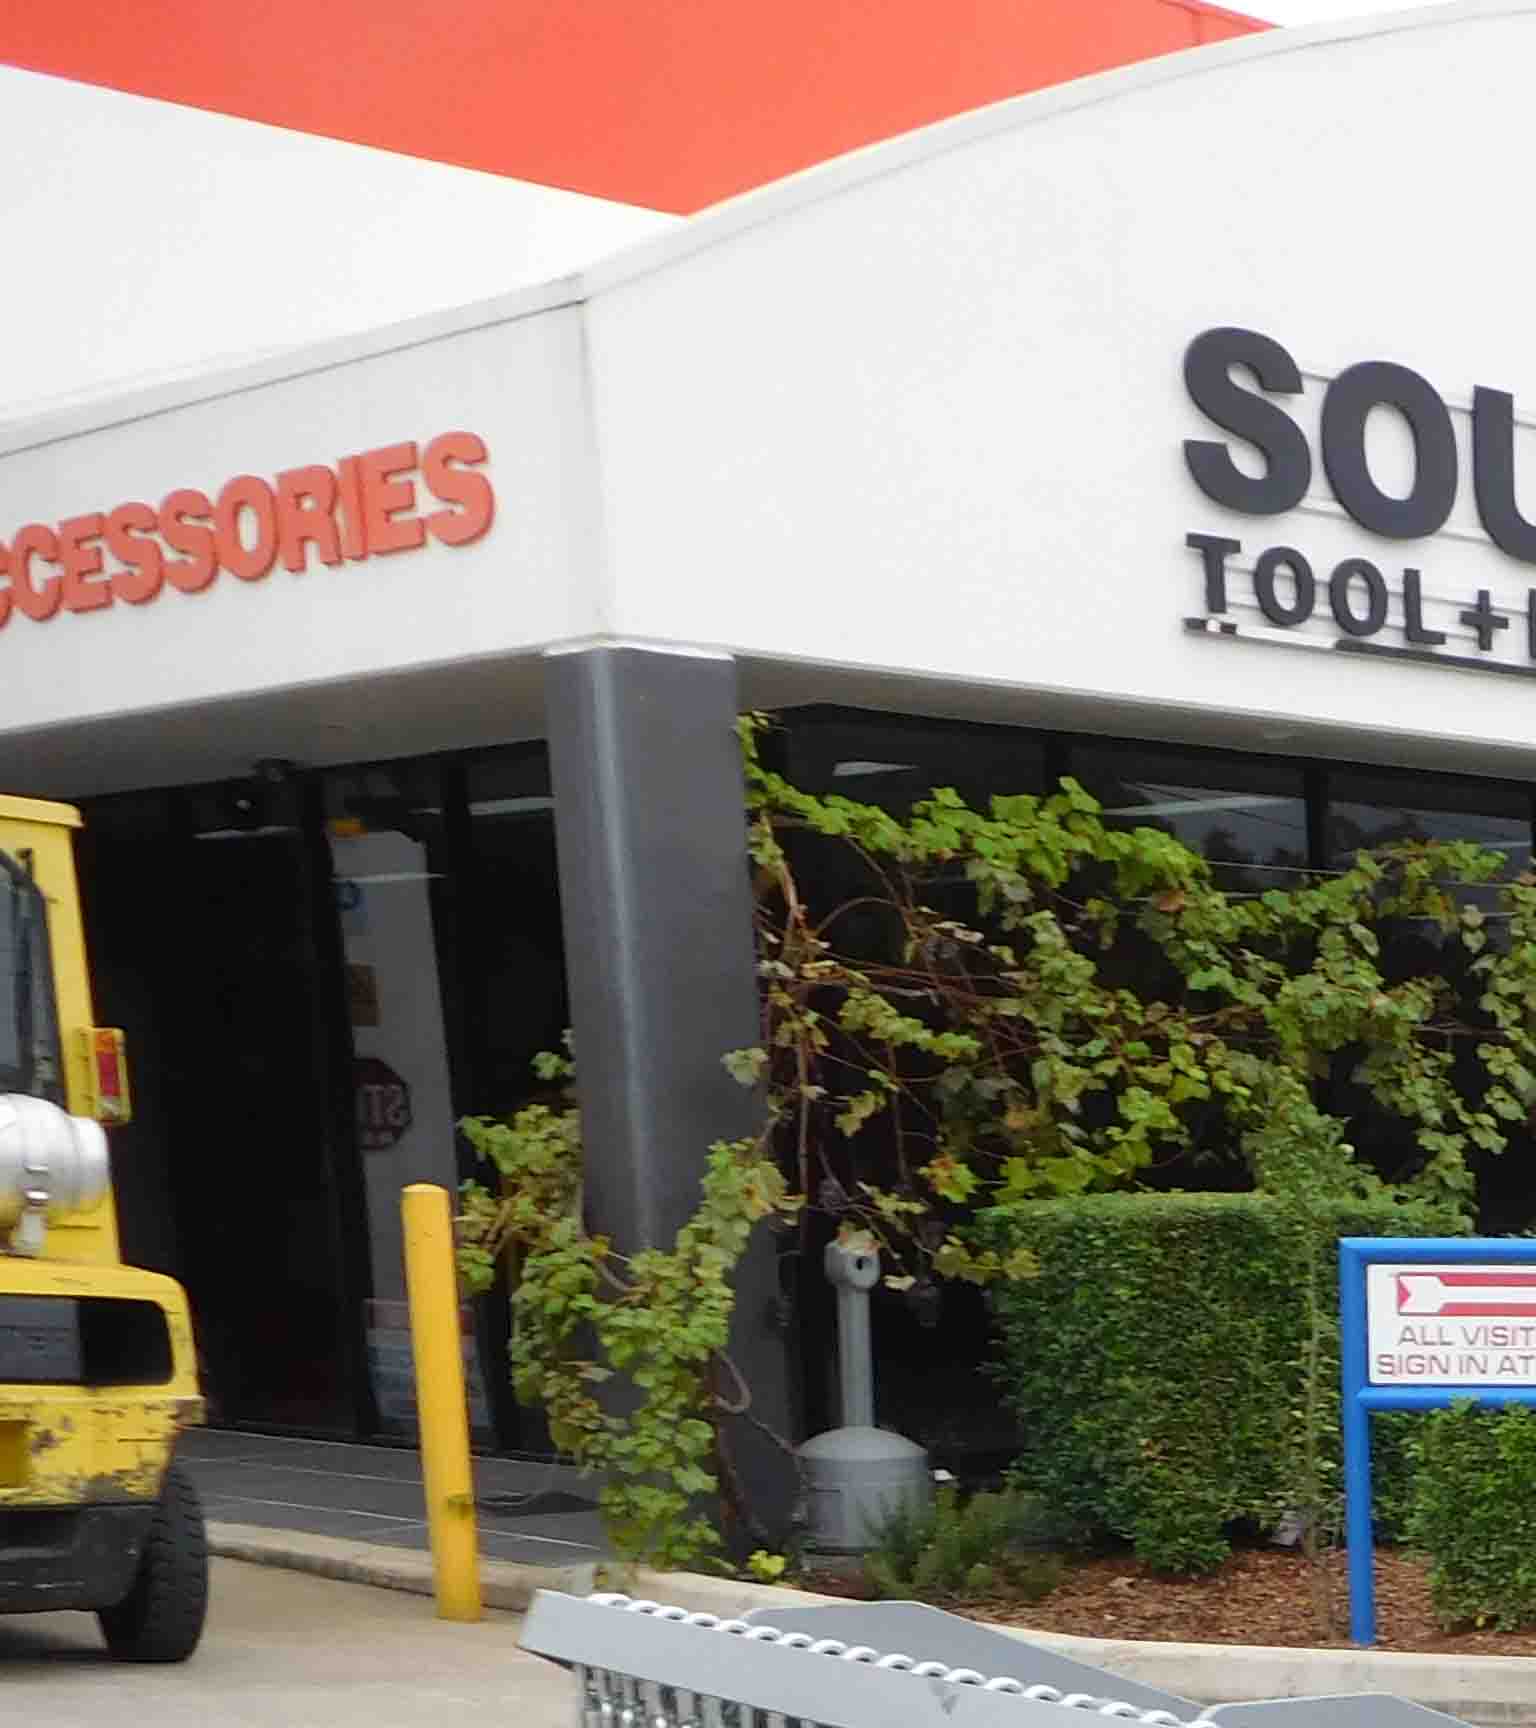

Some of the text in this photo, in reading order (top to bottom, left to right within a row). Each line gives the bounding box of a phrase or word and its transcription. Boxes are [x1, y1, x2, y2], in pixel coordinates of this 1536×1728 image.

[0, 431, 496, 632] CESSORIES
[1397, 1327, 1452, 1347] ALL
[1377, 1354, 1450, 1376] SIGN
[1457, 1354, 1488, 1376] IN
[1496, 1354, 1536, 1376] AT
